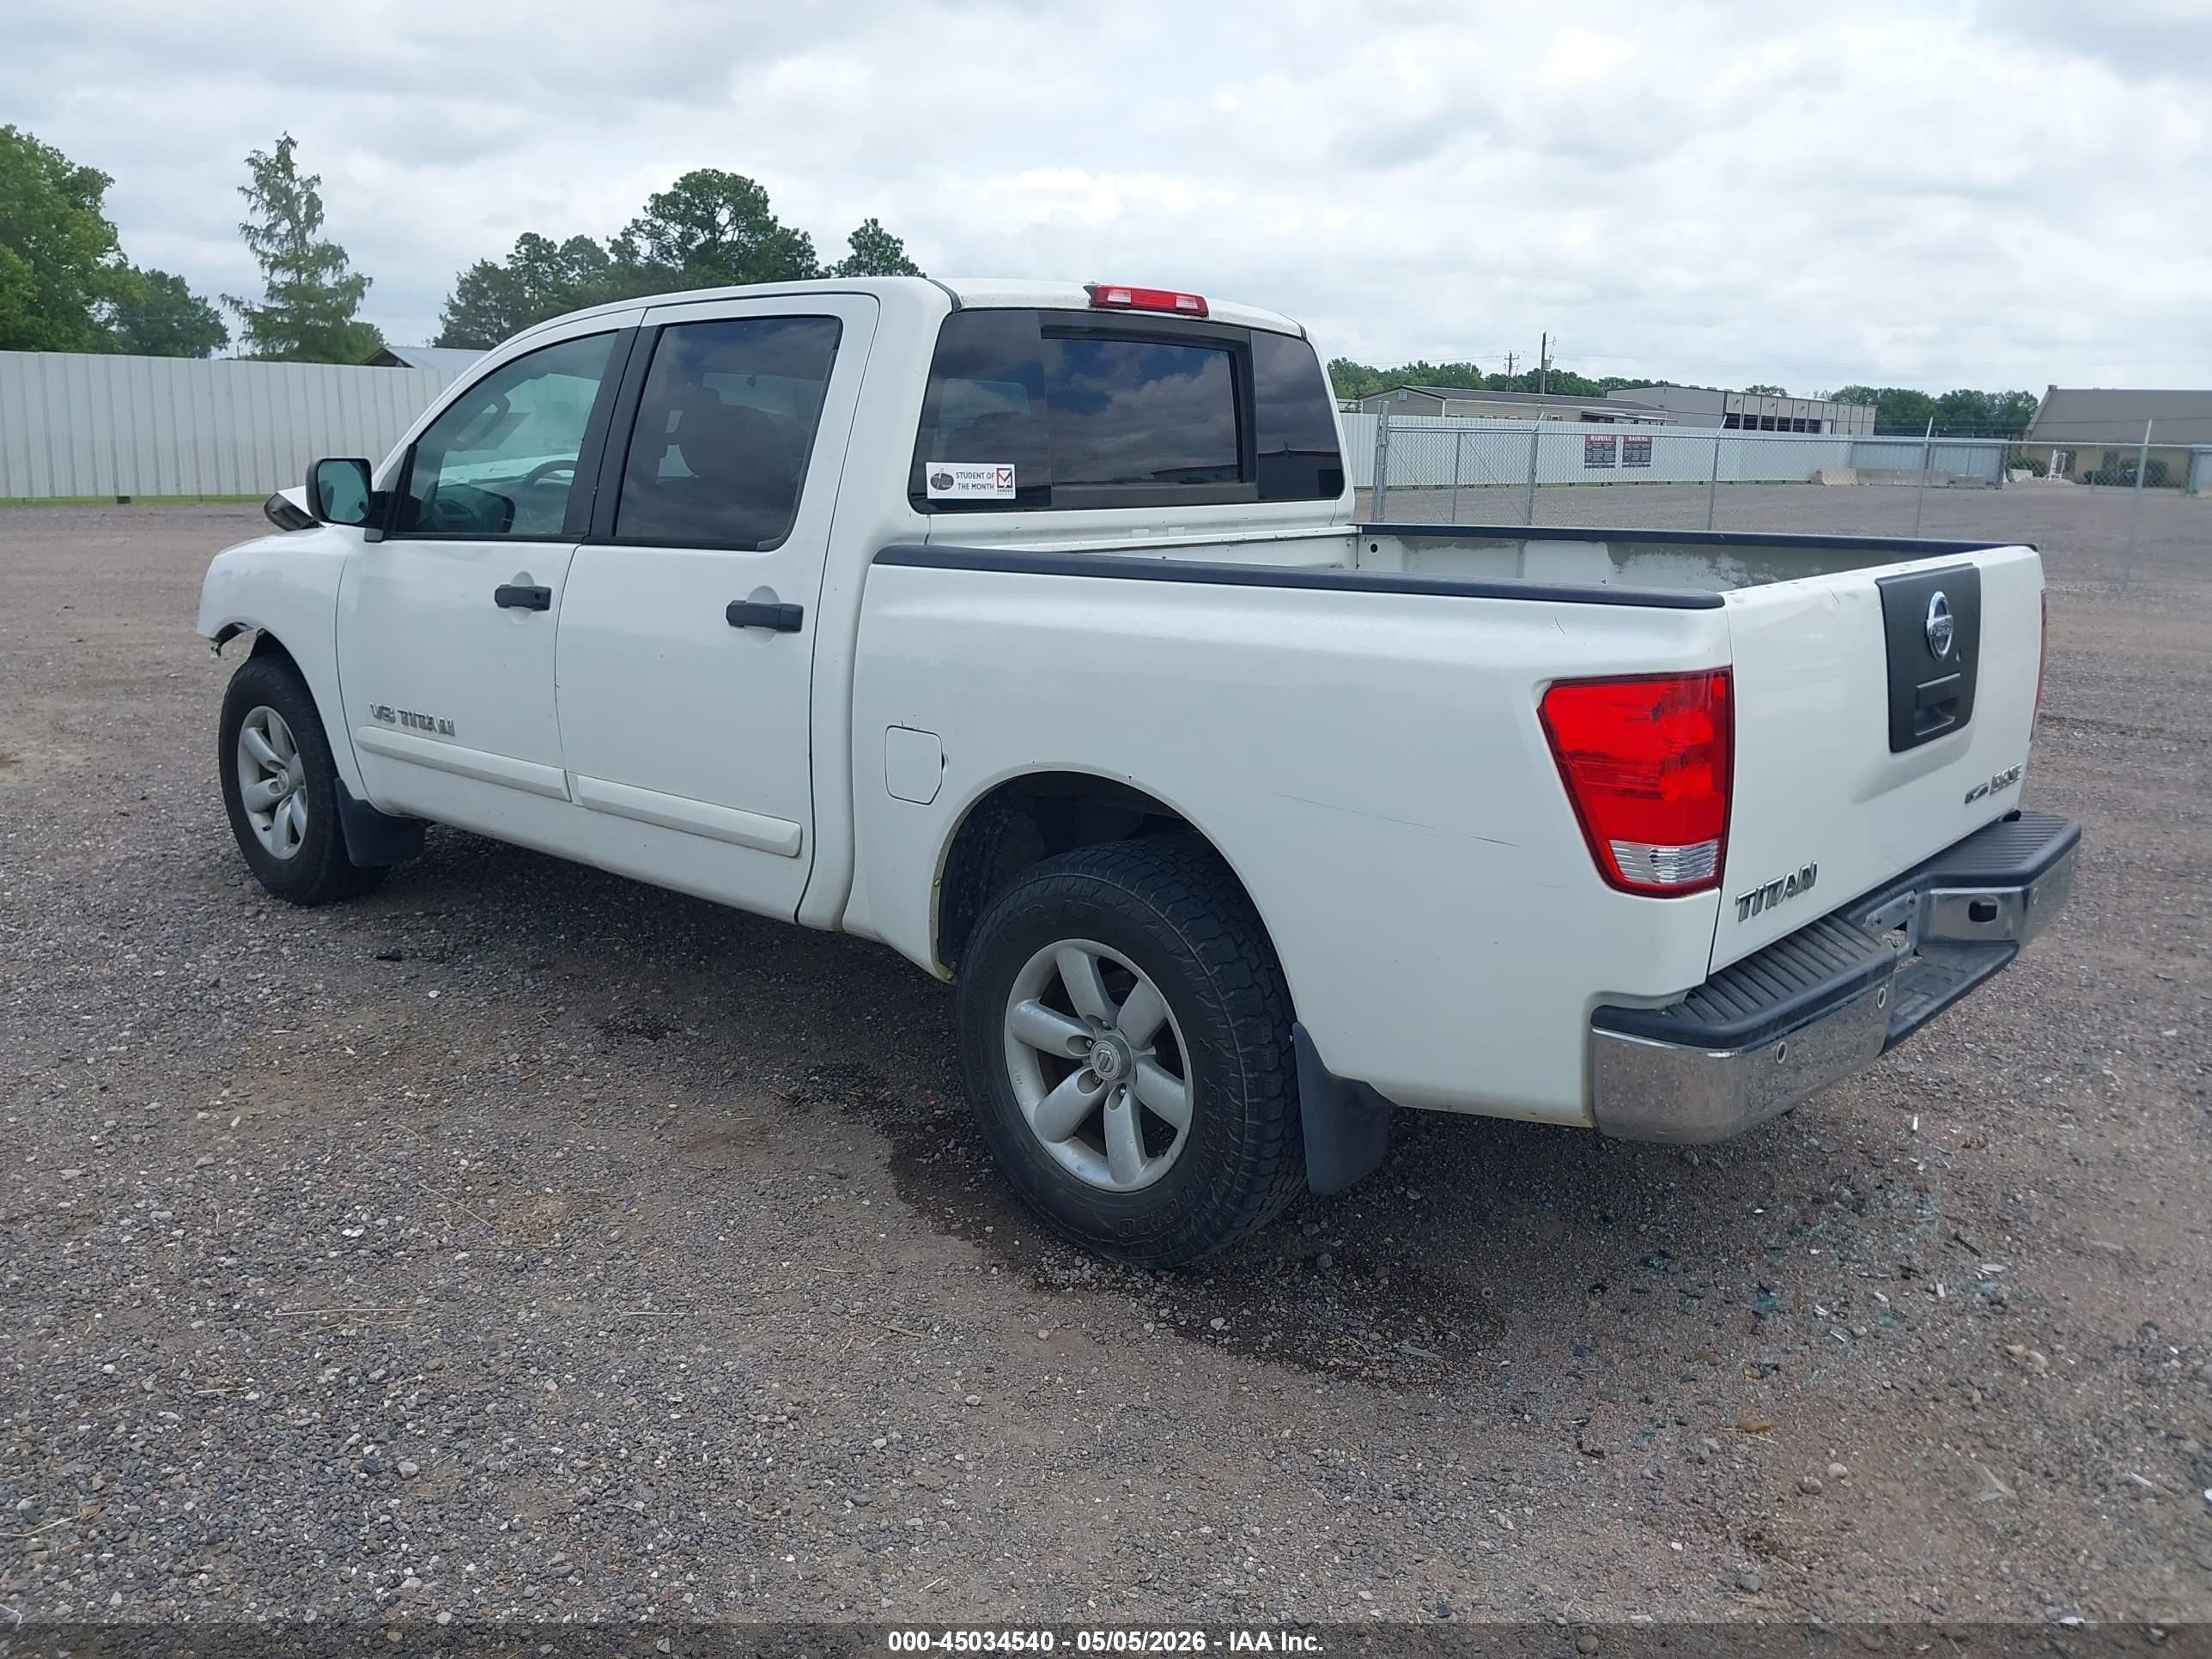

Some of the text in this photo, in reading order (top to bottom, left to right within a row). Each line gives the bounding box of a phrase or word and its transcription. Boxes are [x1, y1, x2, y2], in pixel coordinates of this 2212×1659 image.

[956, 471, 986, 480] STUDENT
[397, 708, 455, 737] TITAN
[1735, 860, 1818, 922] TITAN
